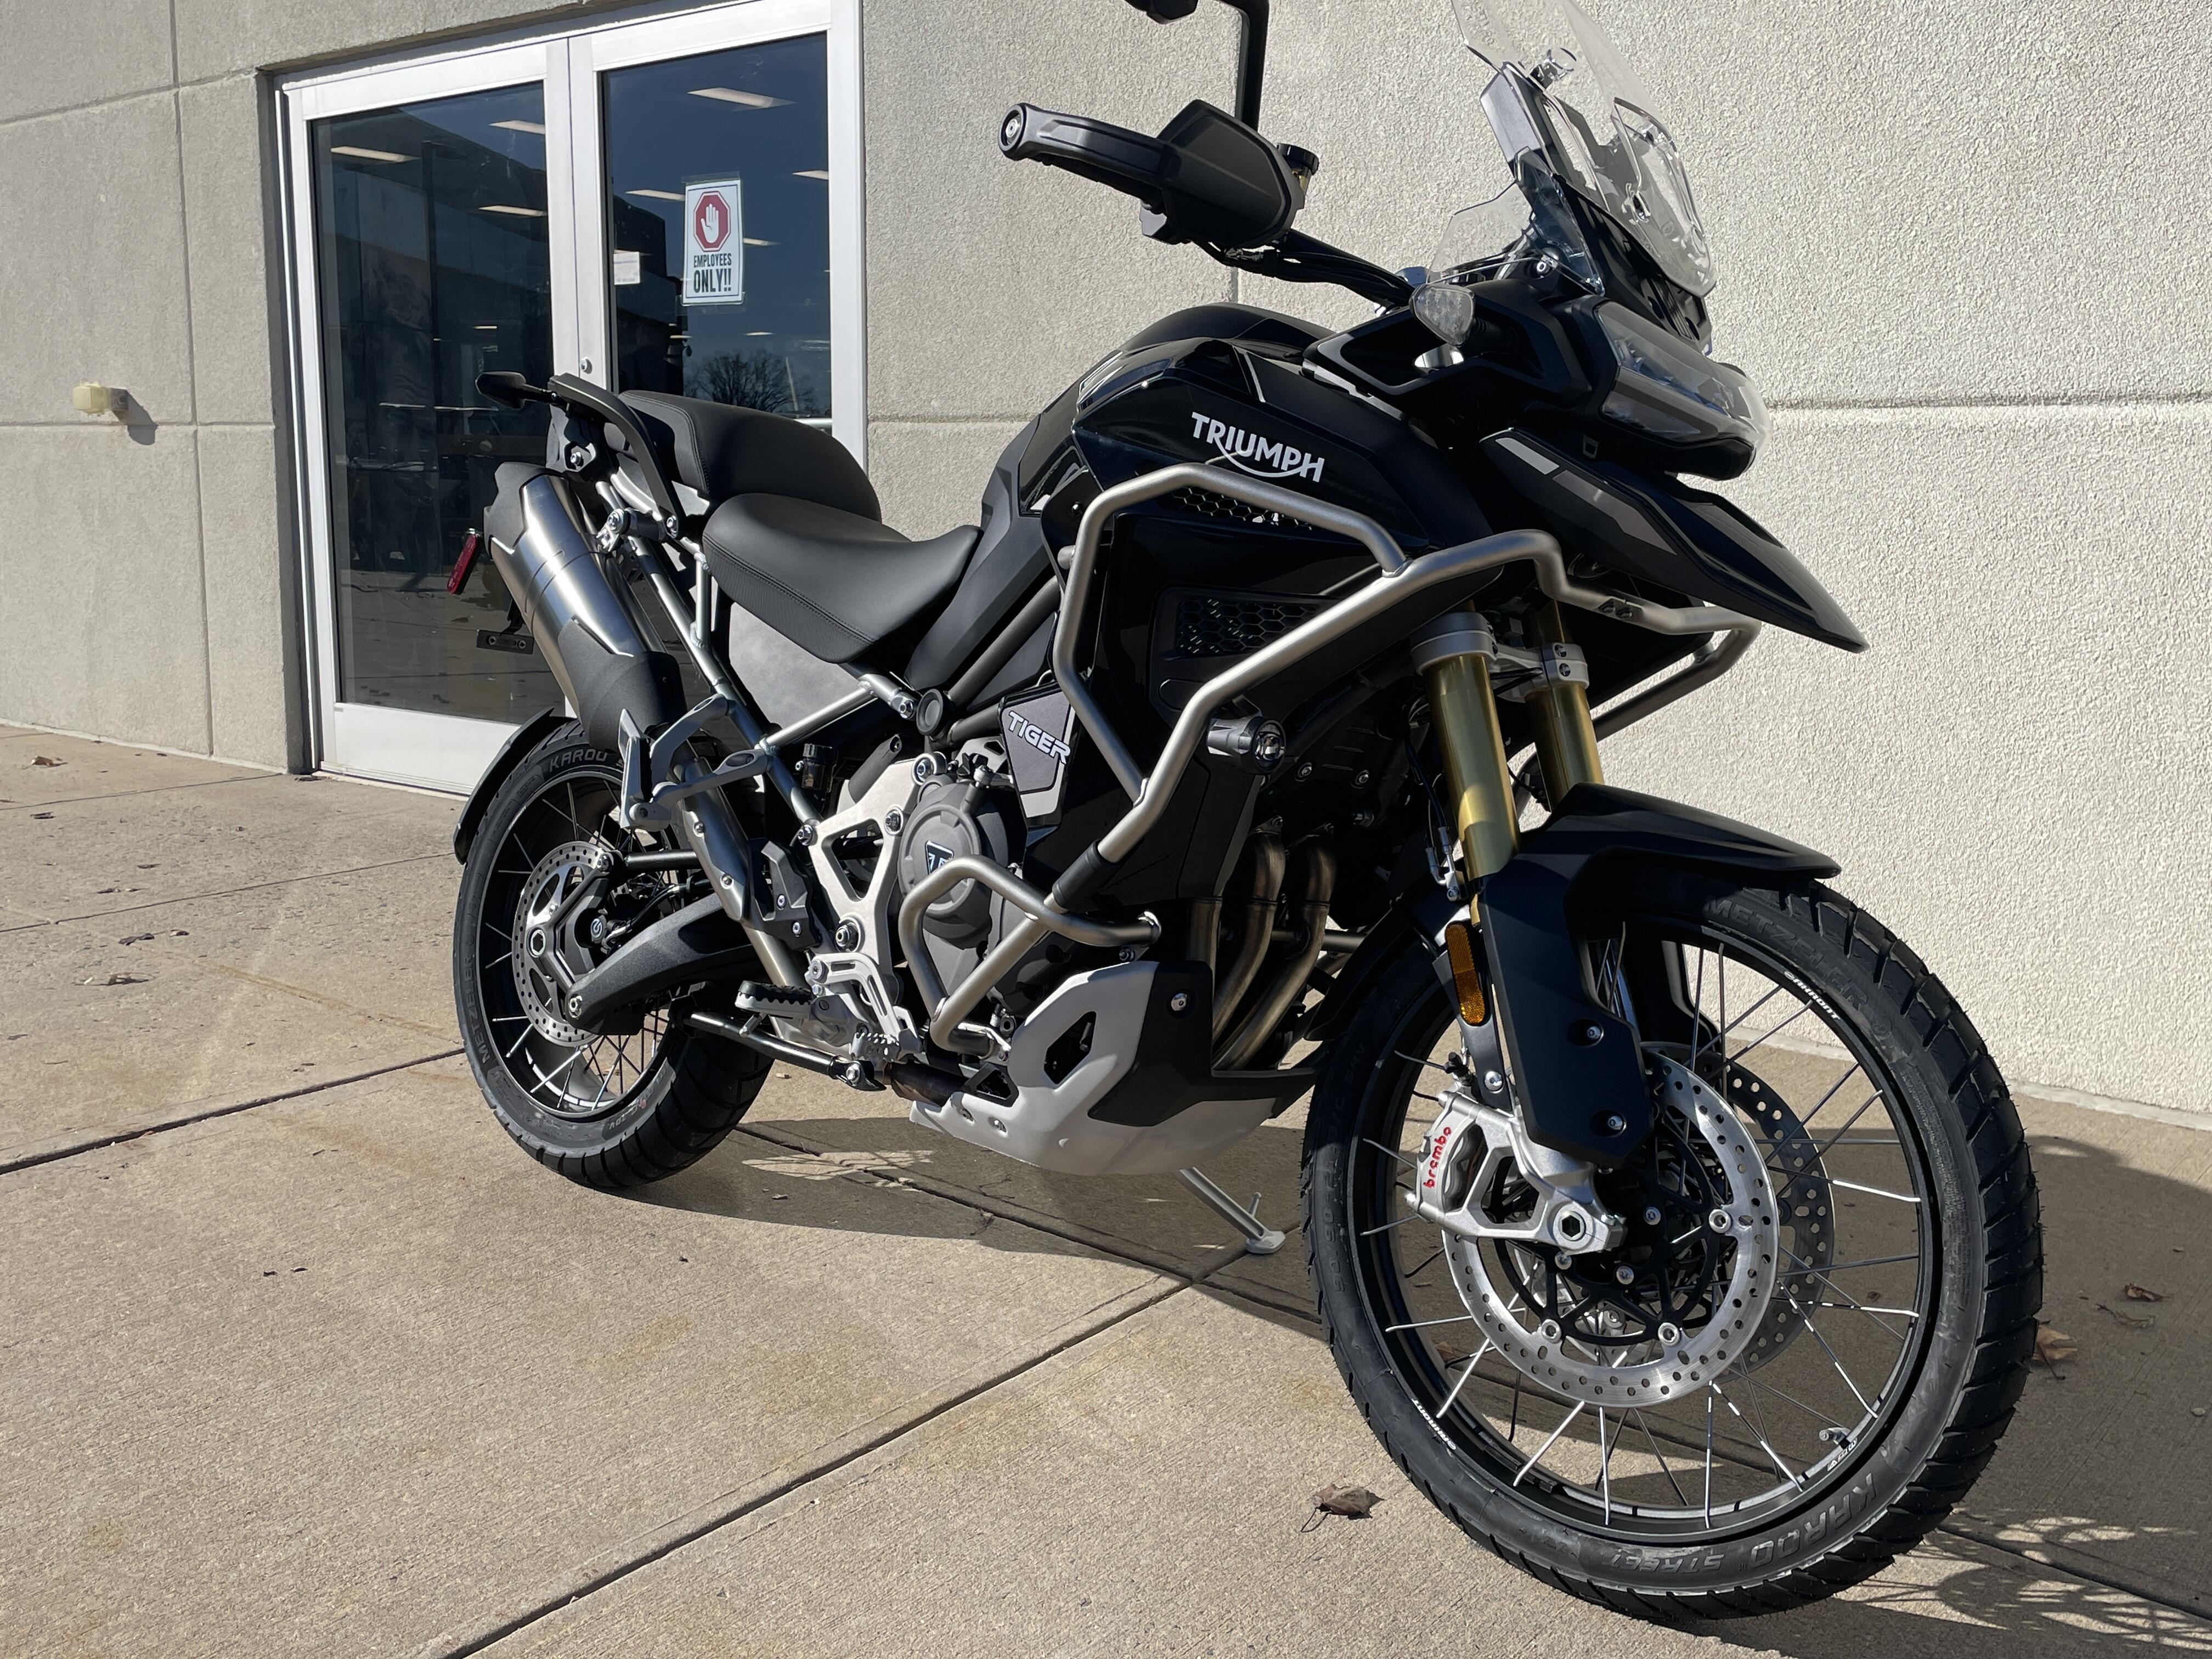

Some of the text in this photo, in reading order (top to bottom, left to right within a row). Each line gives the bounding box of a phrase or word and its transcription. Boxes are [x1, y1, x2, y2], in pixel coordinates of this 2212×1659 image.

[693, 253, 732, 268] EMPLOYEES
[693, 268, 731, 293] ONLY!!
[1191, 411, 1325, 482] TRIUMPH
[1008, 710, 1071, 765] TIGER
[464, 954, 491, 1063] METZELER
[1423, 1126, 1452, 1189] brembo
[1602, 1472, 1877, 1574] KAROO STREET
